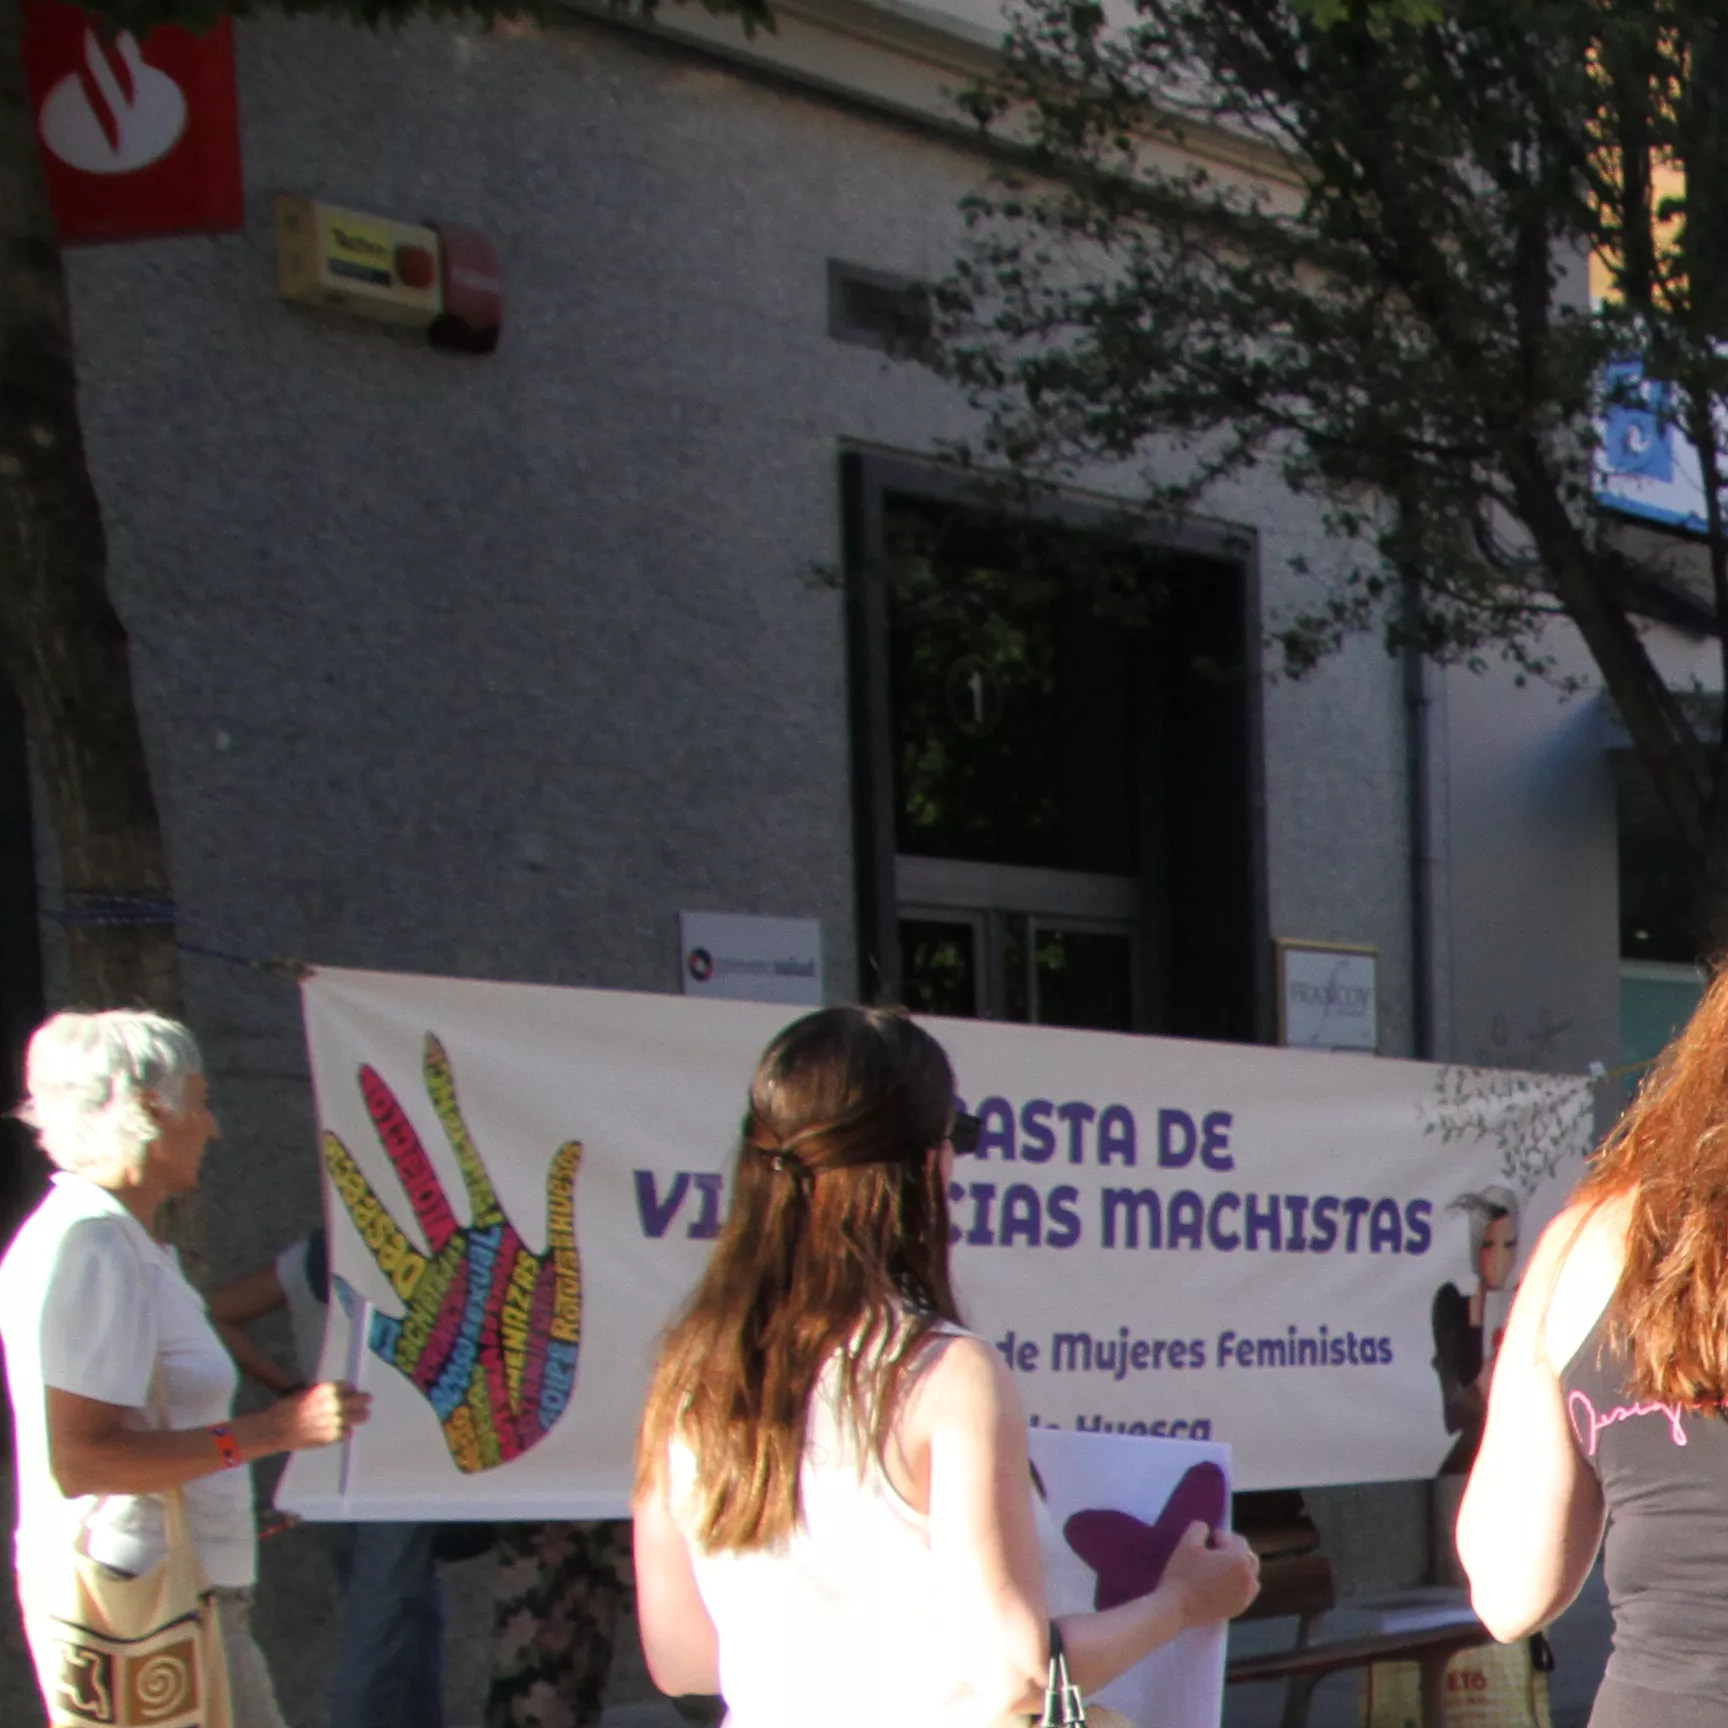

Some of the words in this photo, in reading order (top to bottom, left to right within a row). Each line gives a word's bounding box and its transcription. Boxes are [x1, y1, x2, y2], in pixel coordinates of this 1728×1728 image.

[954, 1096, 1137, 1166] ASTA
[1157, 1106, 1236, 1173] DE
[1100, 1186, 1434, 1256] MACHISTAS
[1052, 1326, 1206, 1381] Mujeres
[1217, 1325, 1394, 1370] Feministas
